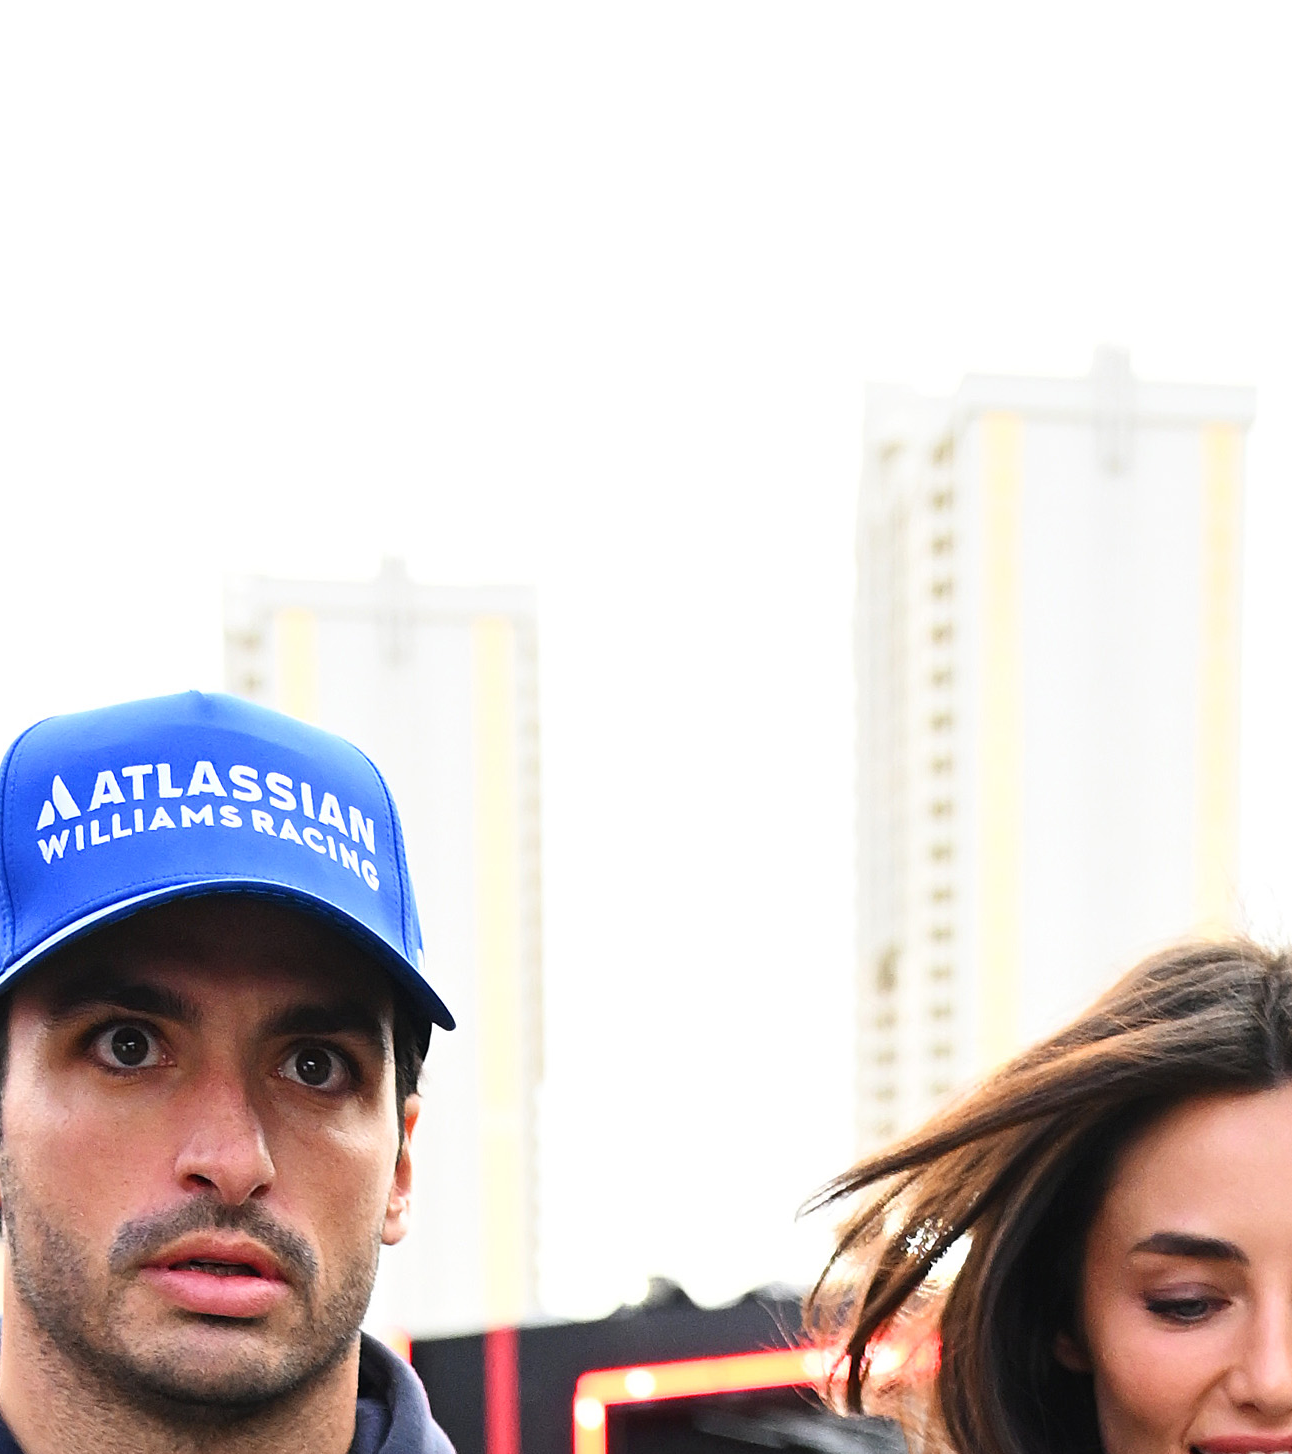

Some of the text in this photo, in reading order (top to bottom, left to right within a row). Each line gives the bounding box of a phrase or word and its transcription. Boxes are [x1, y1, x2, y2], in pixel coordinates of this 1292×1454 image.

[36, 804, 381, 892] WILLIAMS RACING
[88, 760, 377, 855] ATLASSIAN
